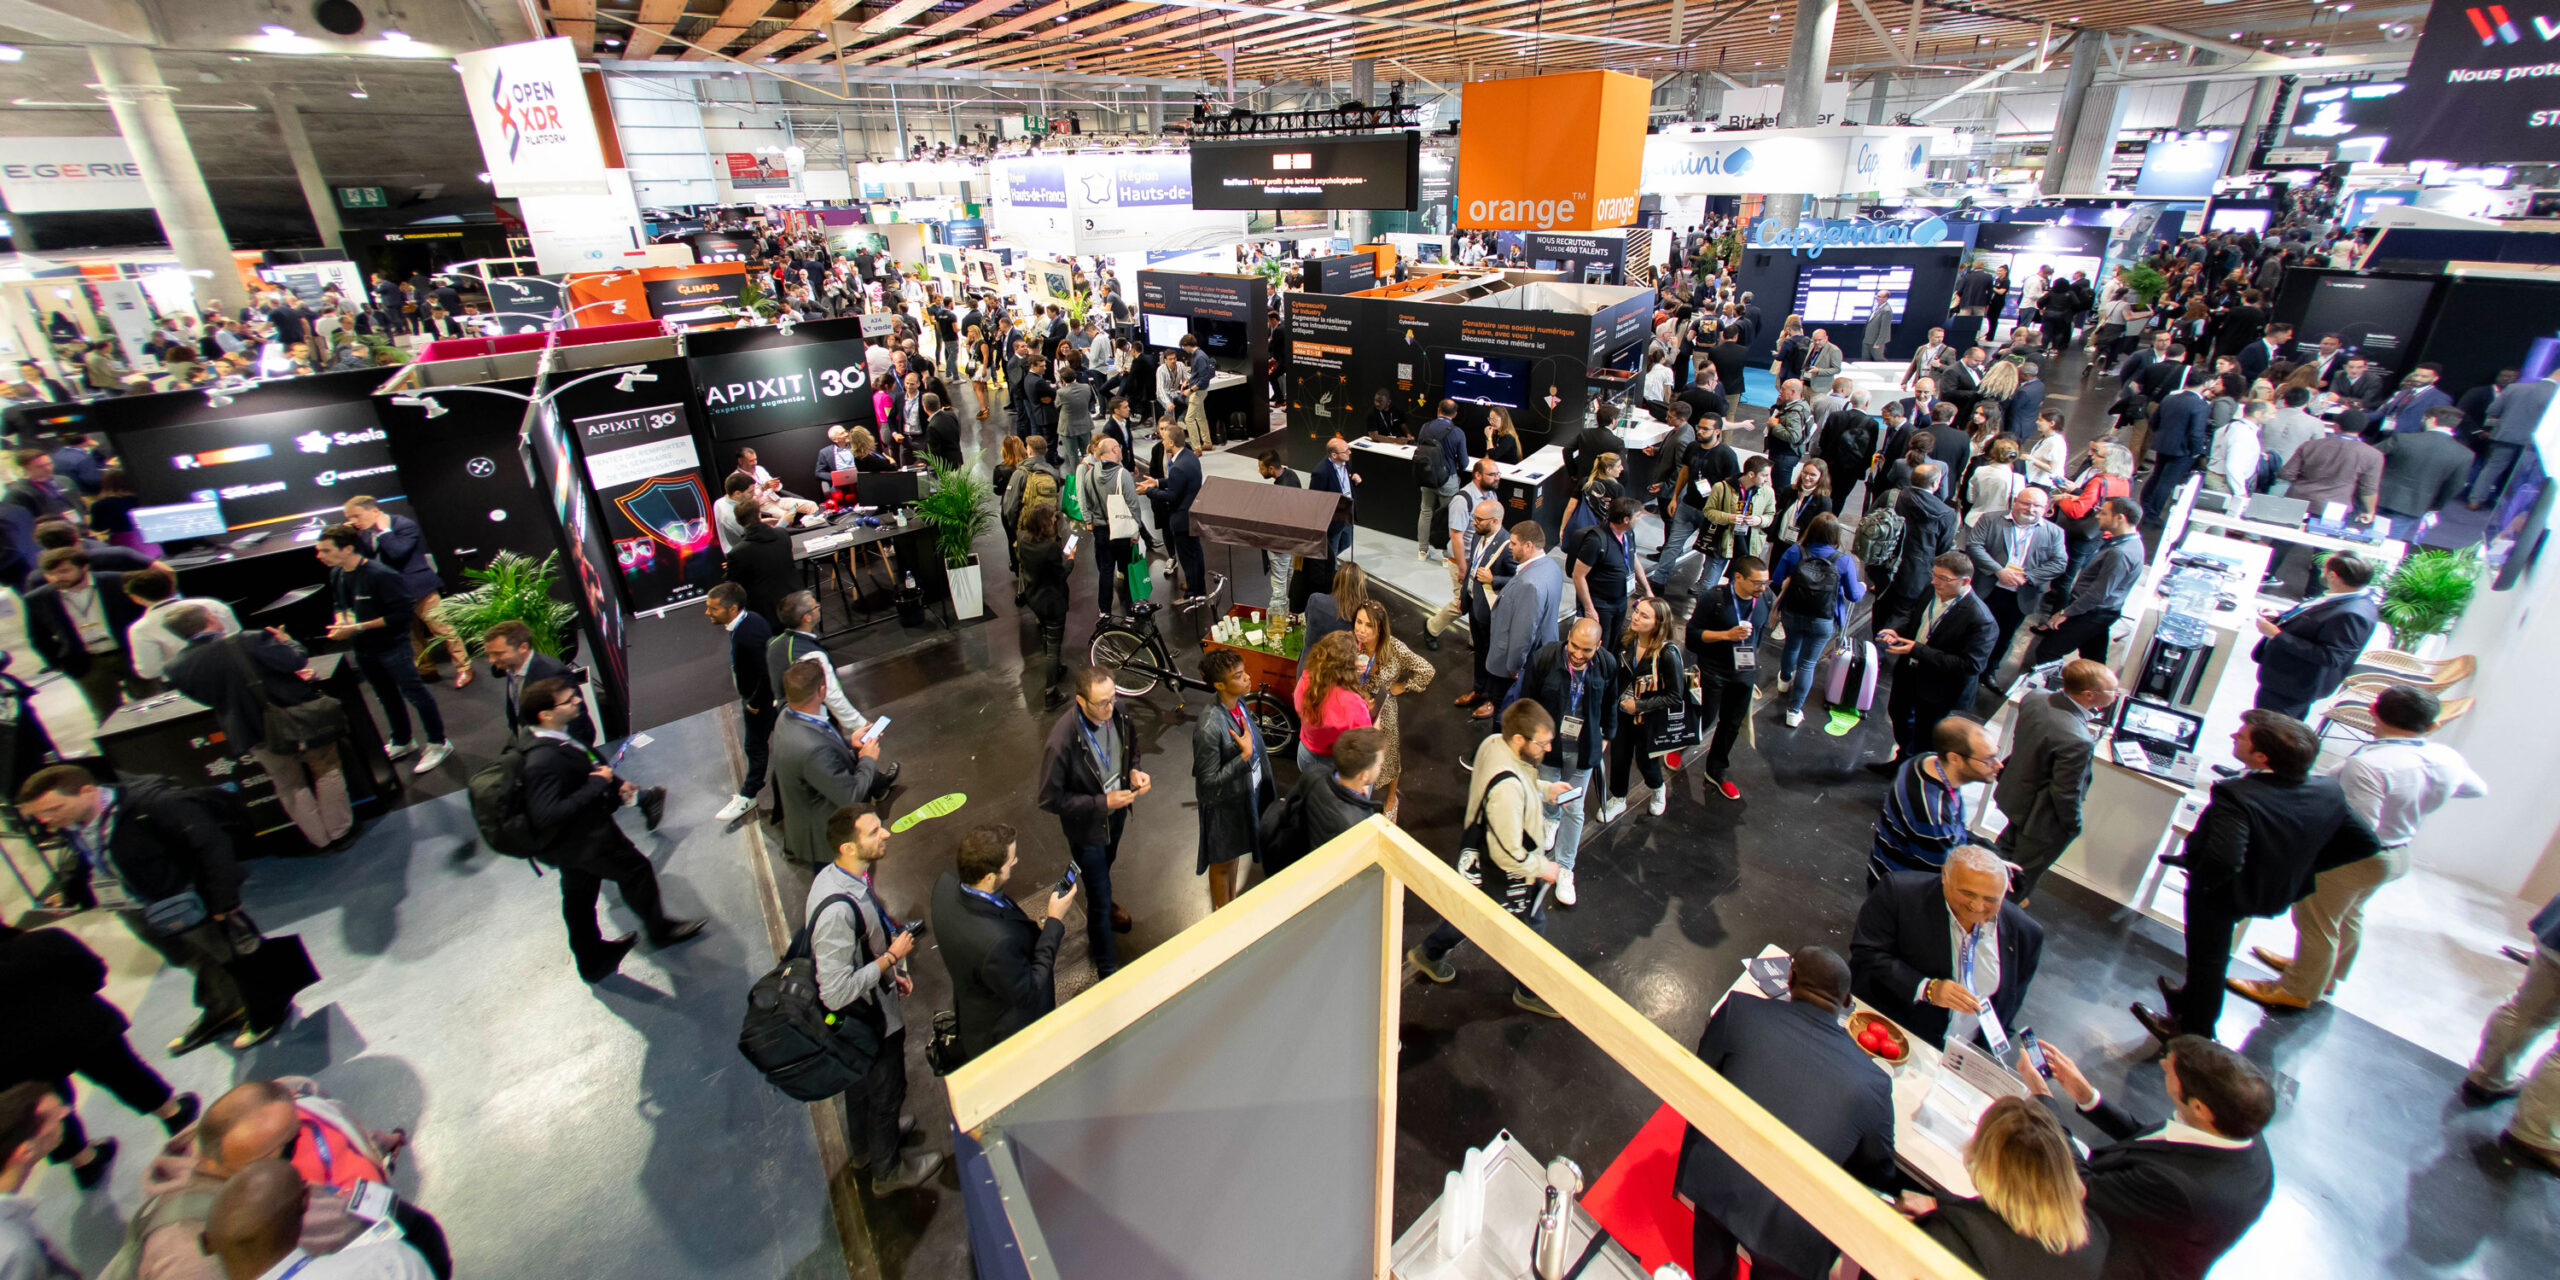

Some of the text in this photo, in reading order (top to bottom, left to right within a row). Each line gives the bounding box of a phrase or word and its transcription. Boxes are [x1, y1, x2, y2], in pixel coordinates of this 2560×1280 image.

[2447, 68, 2502, 84] Nous
[512, 80, 556, 104] OPEN
[518, 105, 564, 131] XDR
[1729, 110, 1835, 130] Bitefer
[2528, 109, 2560, 128] ST
[525, 134, 567, 145] PLATFORM
[2, 162, 142, 180] EGERIE
[1119, 168, 1159, 184] Région
[1119, 184, 1193, 202] Hauts-de-
[1469, 199, 1575, 229] orange
[1597, 196, 1635, 226] orange
[1537, 236, 1596, 248] NOUS RECRUTONS
[1756, 217, 1909, 260] Capgemini
[1565, 246, 1578, 254] 400
[1579, 246, 1609, 257] TALENTS
[677, 283, 720, 296] GLIMPS
[1291, 301, 1327, 311] Cybersecurity
[1292, 314, 1321, 323] Augmenter
[1326, 317, 1352, 326] résilience
[1309, 322, 1348, 332] infrastructures
[1398, 319, 1430, 327] Cyberdefense
[1461, 319, 1576, 337] Construire une société numérique
[1461, 334, 1496, 344] Découvrez
[1510, 339, 1536, 349] métiers
[1536, 341, 1546, 349] ici
[1494, 330, 1510, 338] avec
[1511, 331, 1529, 340] vous
[705, 365, 866, 407] APIXIT 30
[761, 395, 806, 408] augmentée
[587, 417, 641, 436] APIXIT
[649, 410, 676, 429] 30
[333, 427, 387, 446] Seela
